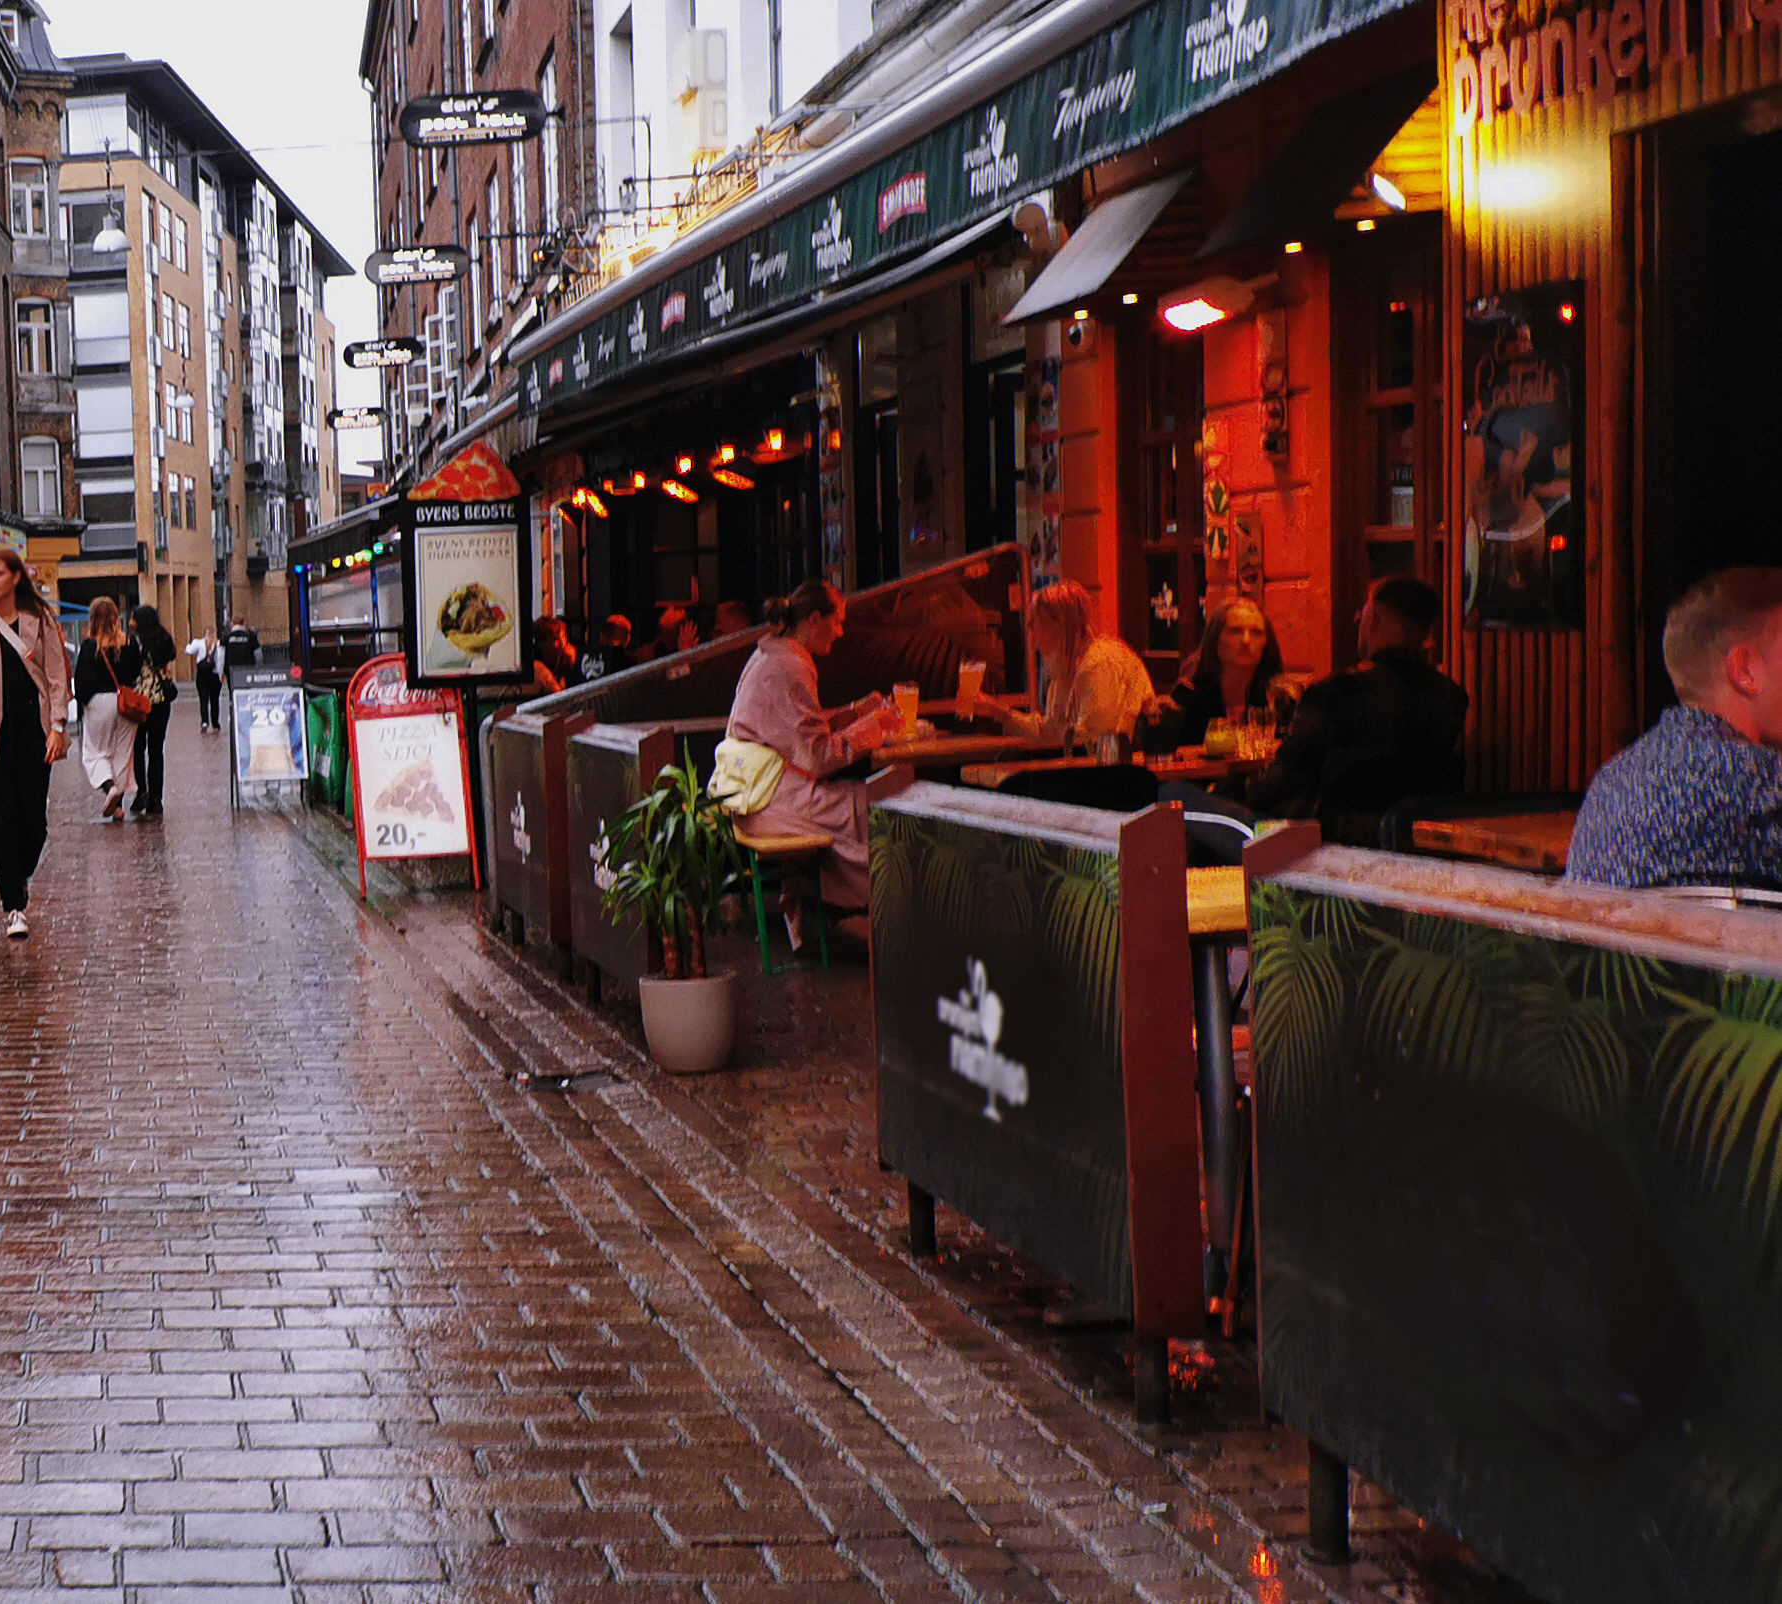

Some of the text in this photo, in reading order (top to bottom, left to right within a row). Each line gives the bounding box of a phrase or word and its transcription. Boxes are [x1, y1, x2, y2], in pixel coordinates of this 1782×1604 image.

[441, 96, 499, 113] dan's
[419, 117, 469, 137] pool
[416, 503, 516, 522] BYENS BEDSTE
[252, 708, 286, 727] 20
